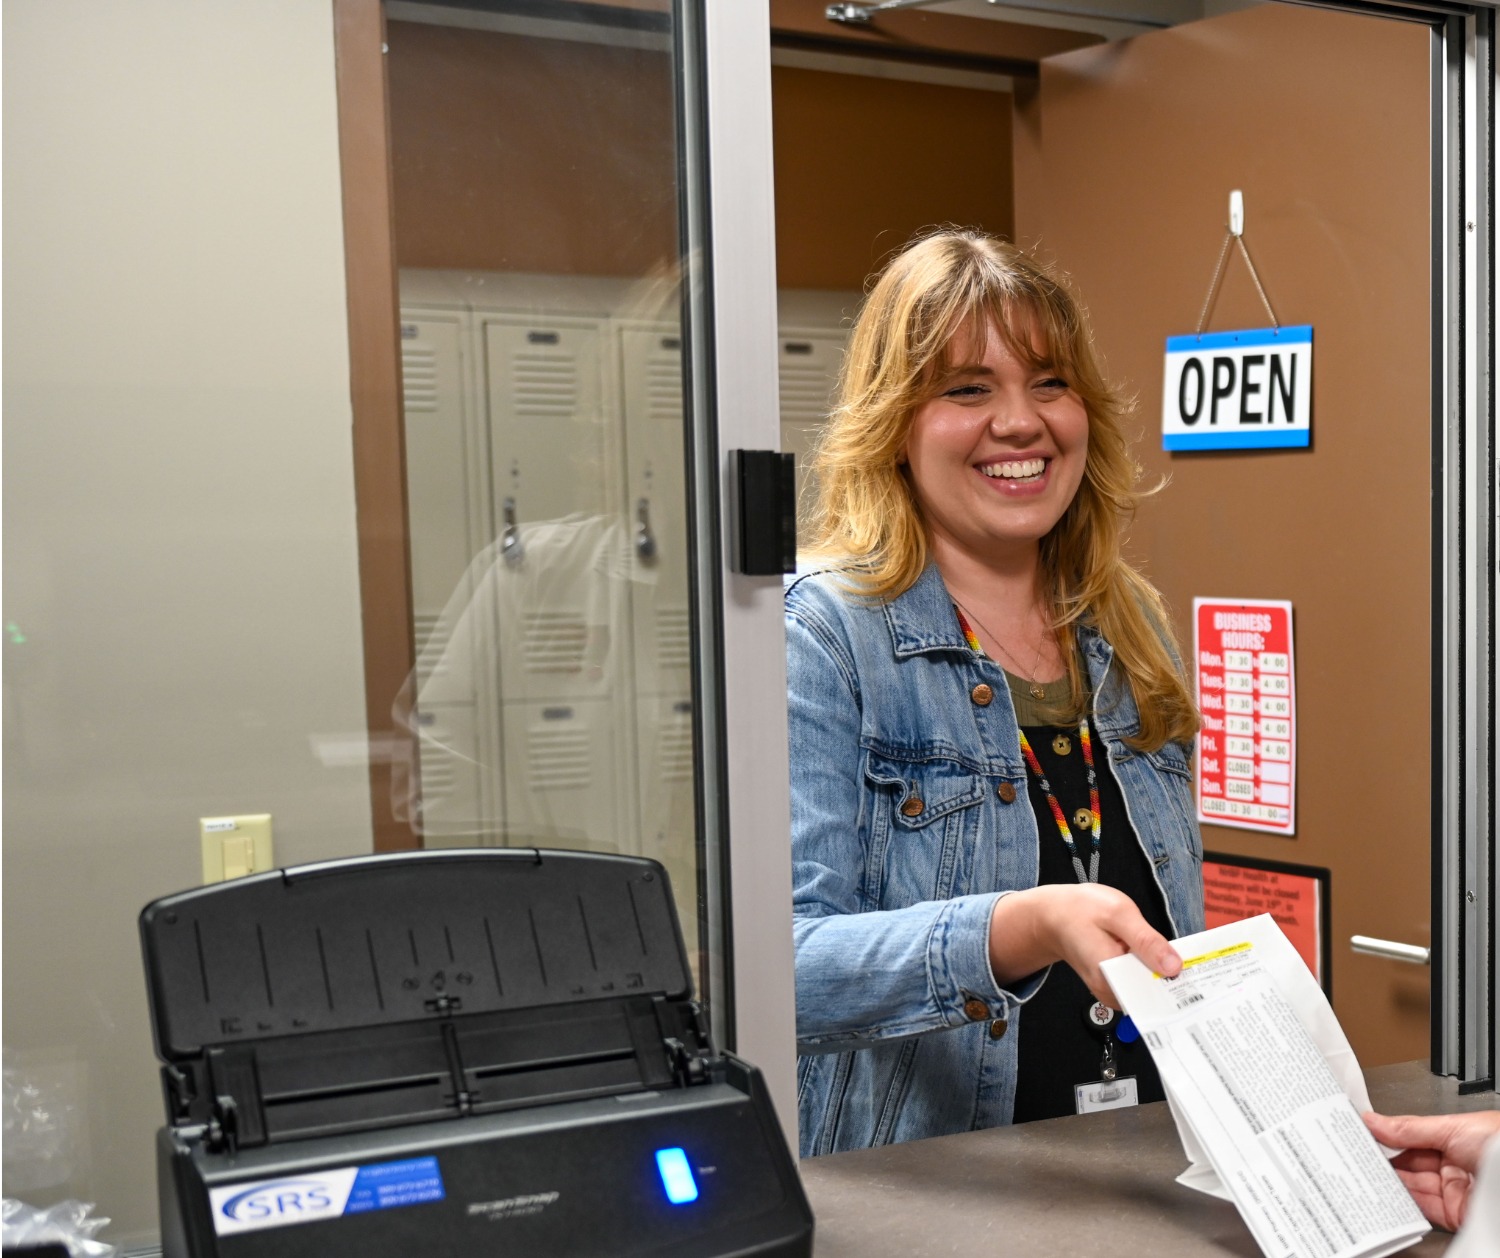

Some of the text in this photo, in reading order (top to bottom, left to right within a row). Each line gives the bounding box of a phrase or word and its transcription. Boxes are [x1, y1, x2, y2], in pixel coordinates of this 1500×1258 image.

[1179, 353, 1297, 426] OPEN
[1213, 612, 1272, 633] BUSINESS
[1222, 631, 1265, 651] HOURS:
[1200, 651, 1224, 667] Mon.
[1202, 694, 1224, 710] Wed.
[1202, 735, 1217, 751] Fri.
[1202, 757, 1220, 772] Sat.
[1228, 760, 1251, 773] CLOSED
[1202, 778, 1222, 794] Sun.
[1228, 783, 1251, 795] CLOSED
[1203, 800, 1226, 812] CLOSED
[1274, 889, 1300, 900] closed
[247, 1186, 332, 1220] SRS
